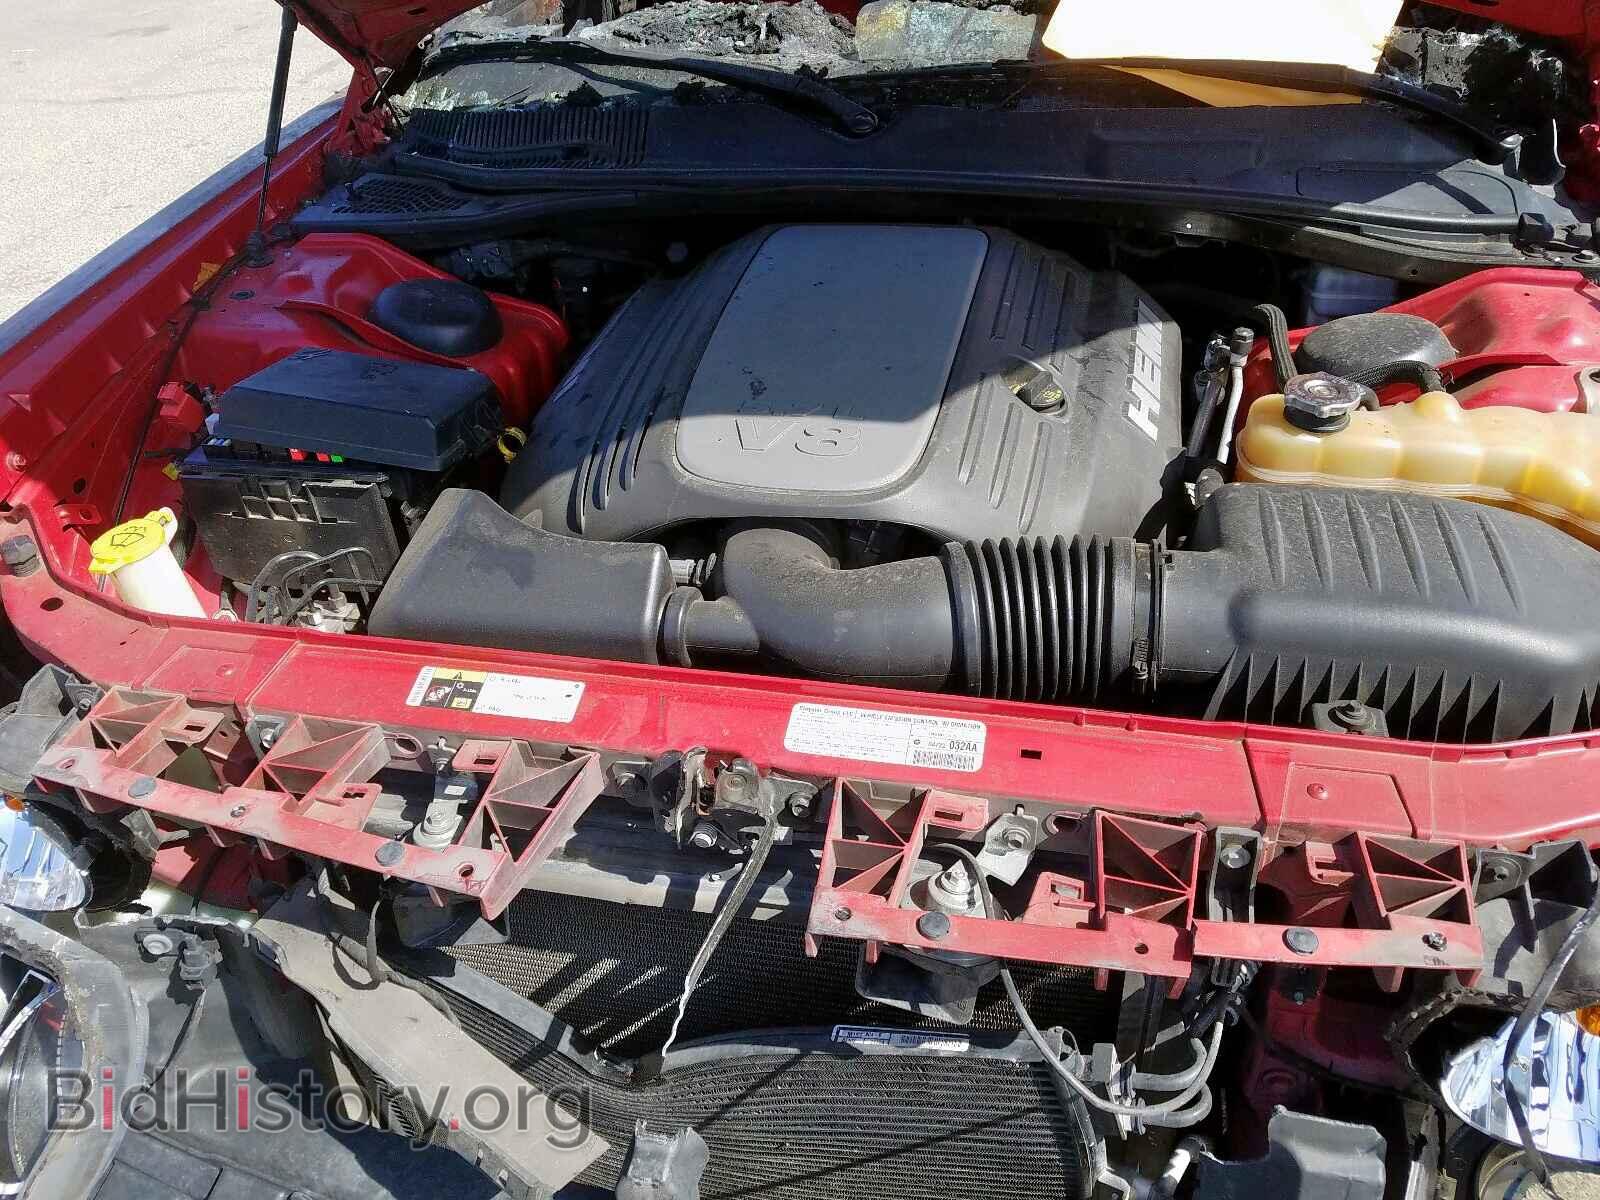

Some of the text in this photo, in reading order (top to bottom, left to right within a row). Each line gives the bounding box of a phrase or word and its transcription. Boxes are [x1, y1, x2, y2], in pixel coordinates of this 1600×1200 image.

[1124, 298, 1163, 442] HEMI
[733, 402, 863, 457] V8
[949, 740, 977, 752] 032AA
